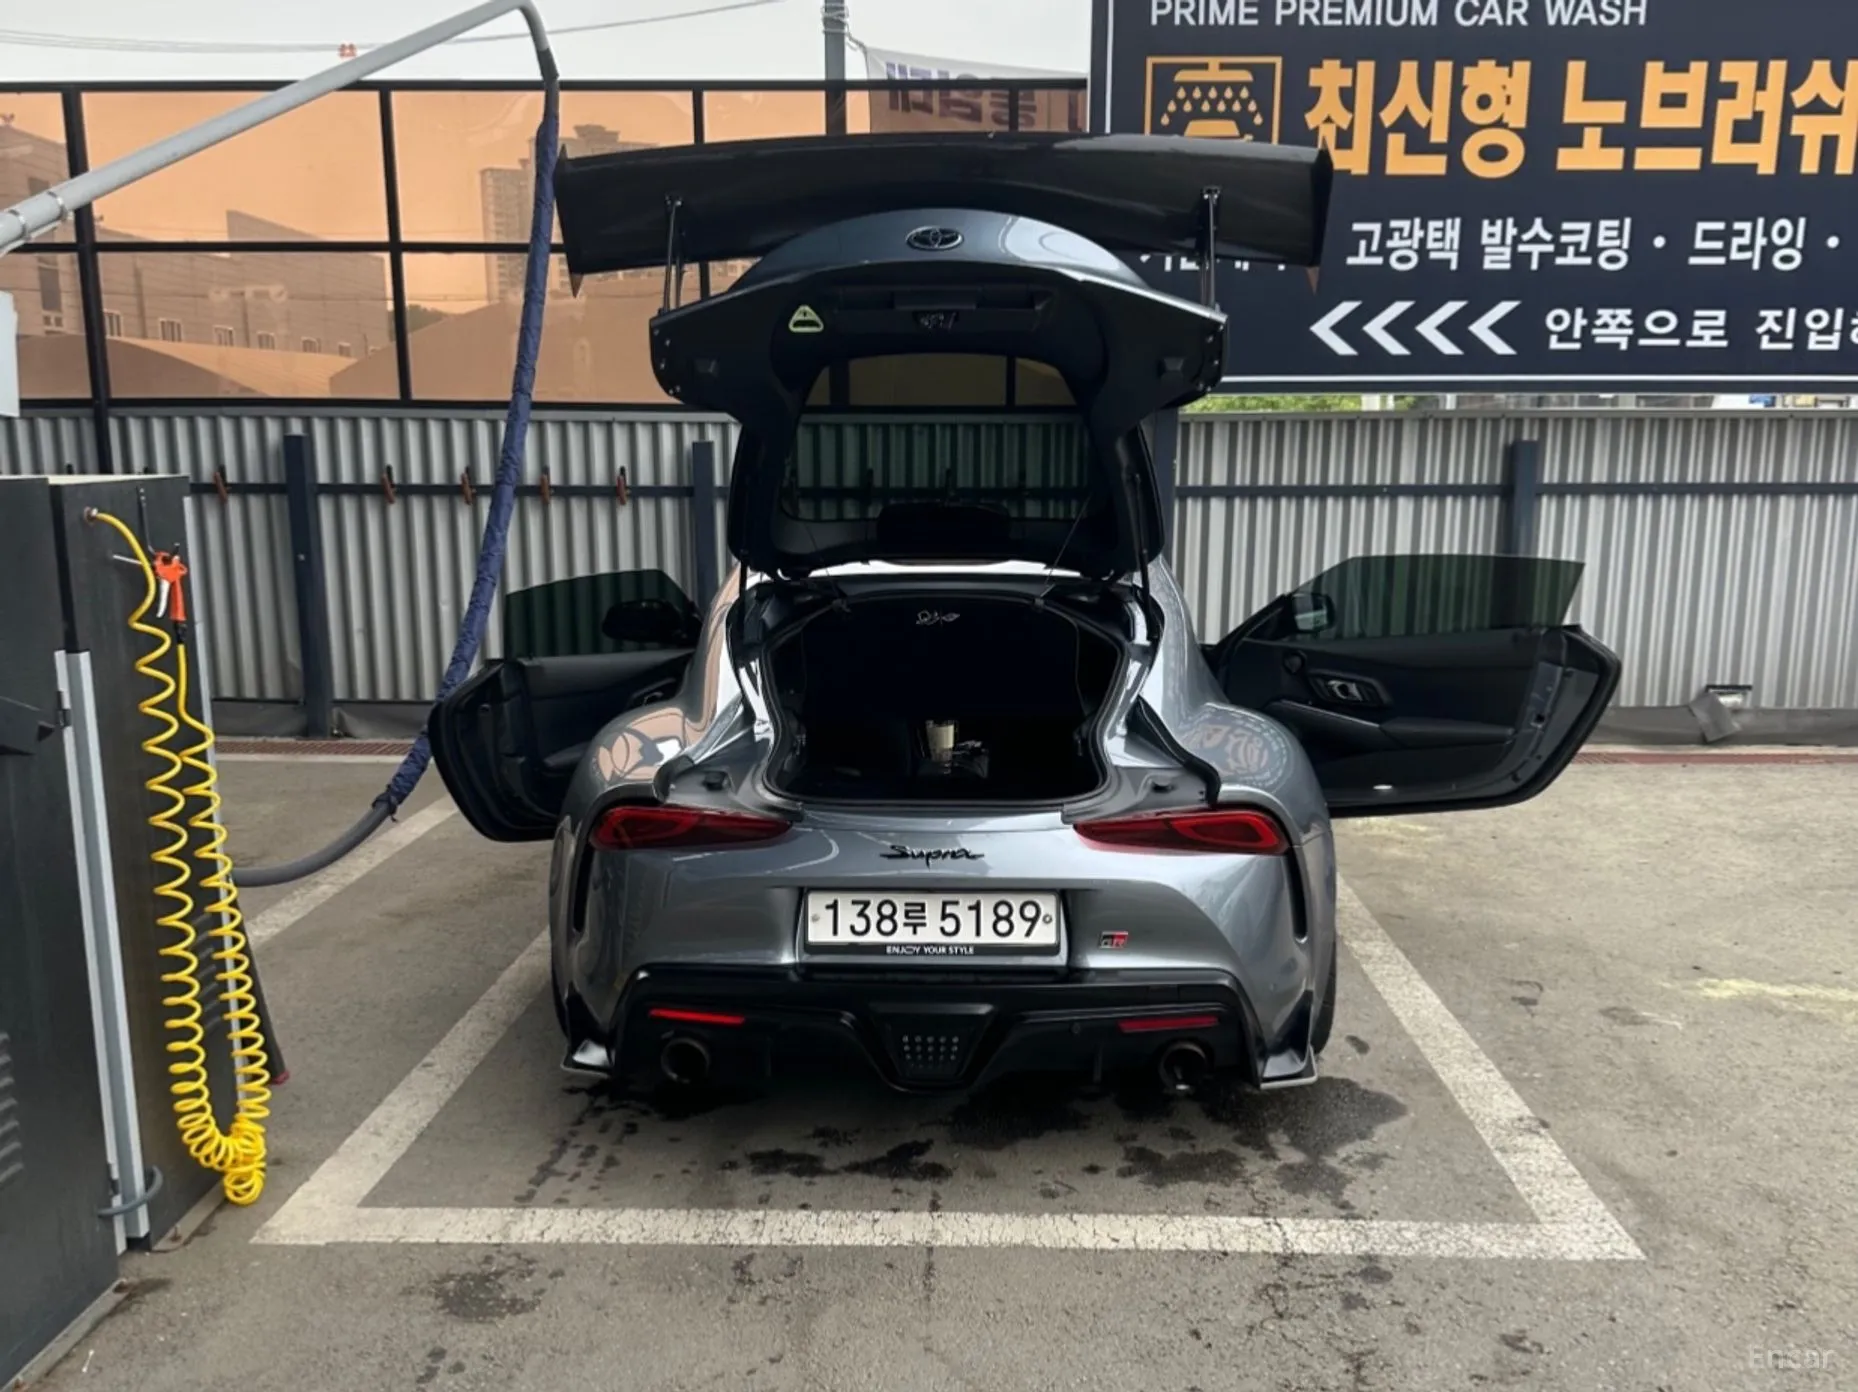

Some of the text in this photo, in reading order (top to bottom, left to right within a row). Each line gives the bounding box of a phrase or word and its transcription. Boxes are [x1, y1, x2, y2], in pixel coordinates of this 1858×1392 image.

[1150, 0, 1647, 26] PRIME PREMIUM CAR WASH
[1303, 58, 1858, 179] 최신형 노브러쉬
[1345, 216, 1807, 272] 고광택 발수코팅 드라잉
[1544, 306, 1858, 351] 안쪽으로 진입
[879, 844, 985, 872] Supra
[824, 898, 1042, 938] 138루 5189
[923, 944, 947, 955] YOUR
[948, 944, 975, 955] STYLE
